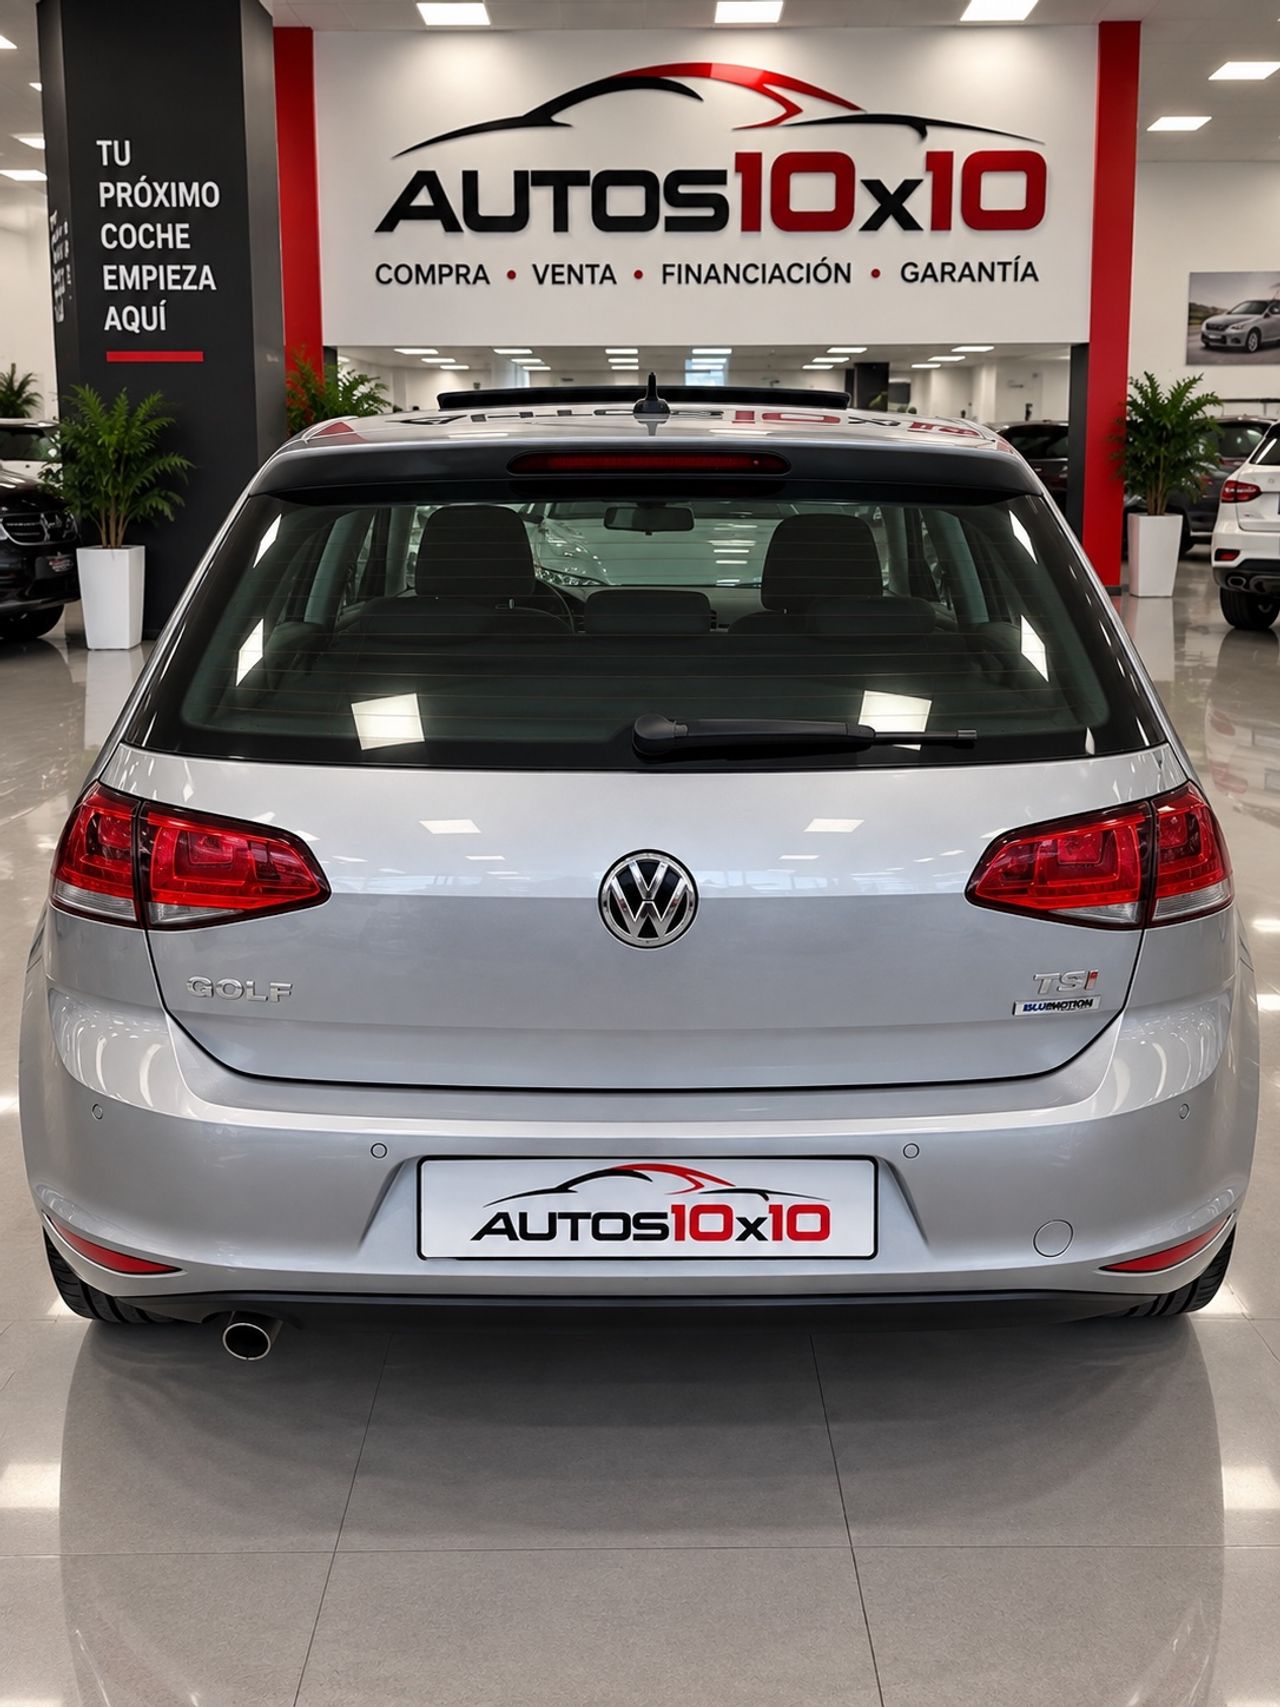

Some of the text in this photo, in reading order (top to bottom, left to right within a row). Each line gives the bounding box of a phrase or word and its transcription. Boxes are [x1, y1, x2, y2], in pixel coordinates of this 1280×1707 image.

[96, 140, 131, 166] TU
[99, 175, 220, 208] PRÓXIMO
[374, 150, 1048, 233] AUTOS10x10
[101, 223, 190, 249] COCHE
[103, 265, 217, 291] EMPIEZA
[375, 256, 1040, 285] COMPRA VENTA FINANCIACIÓN GARANTÍA
[104, 300, 167, 333] AQUÍ
[186, 975, 293, 1003] GOLF
[470, 1203, 831, 1242] AUTOS10x10
